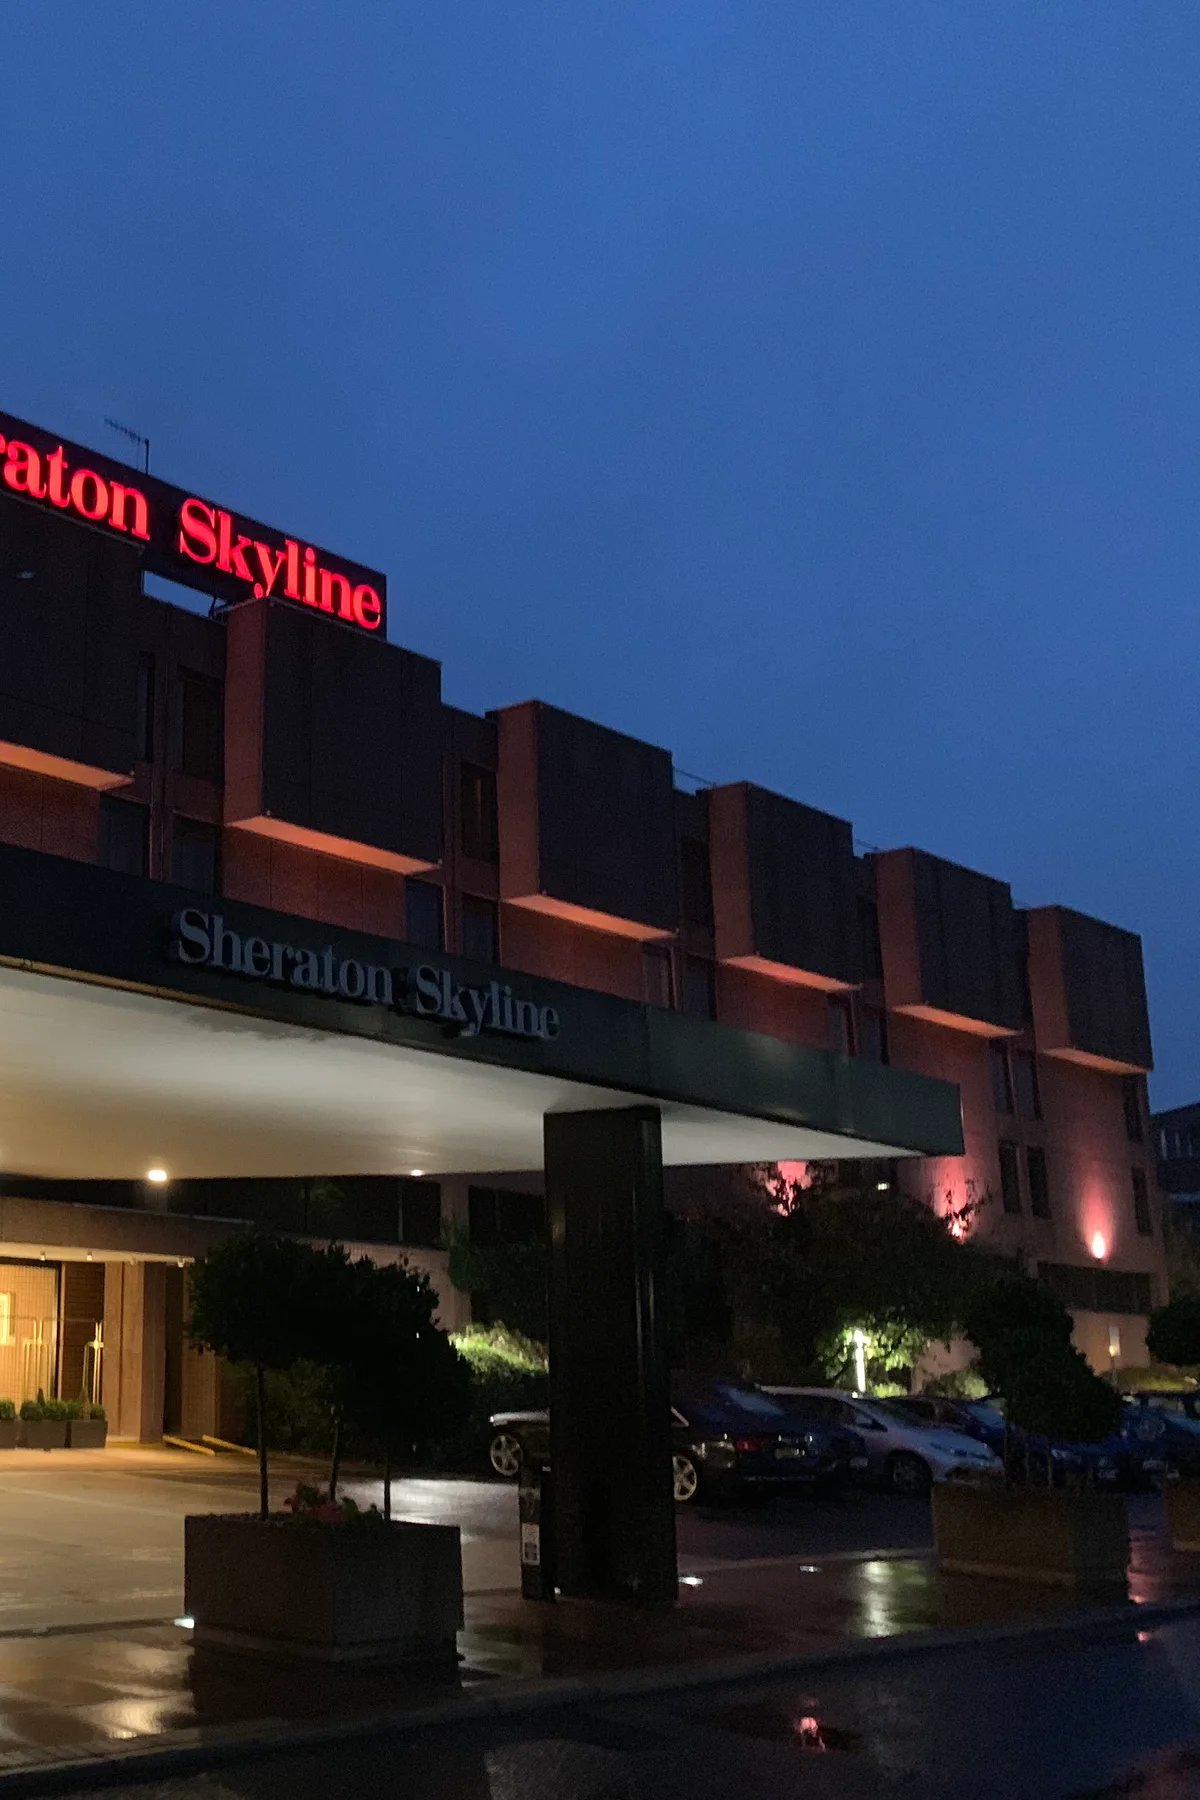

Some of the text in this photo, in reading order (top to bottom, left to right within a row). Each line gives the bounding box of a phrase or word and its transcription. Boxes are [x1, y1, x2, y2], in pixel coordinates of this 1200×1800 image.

[178, 497, 381, 631] Skyline
[176, 908, 560, 1041] Sheraton Skyline
